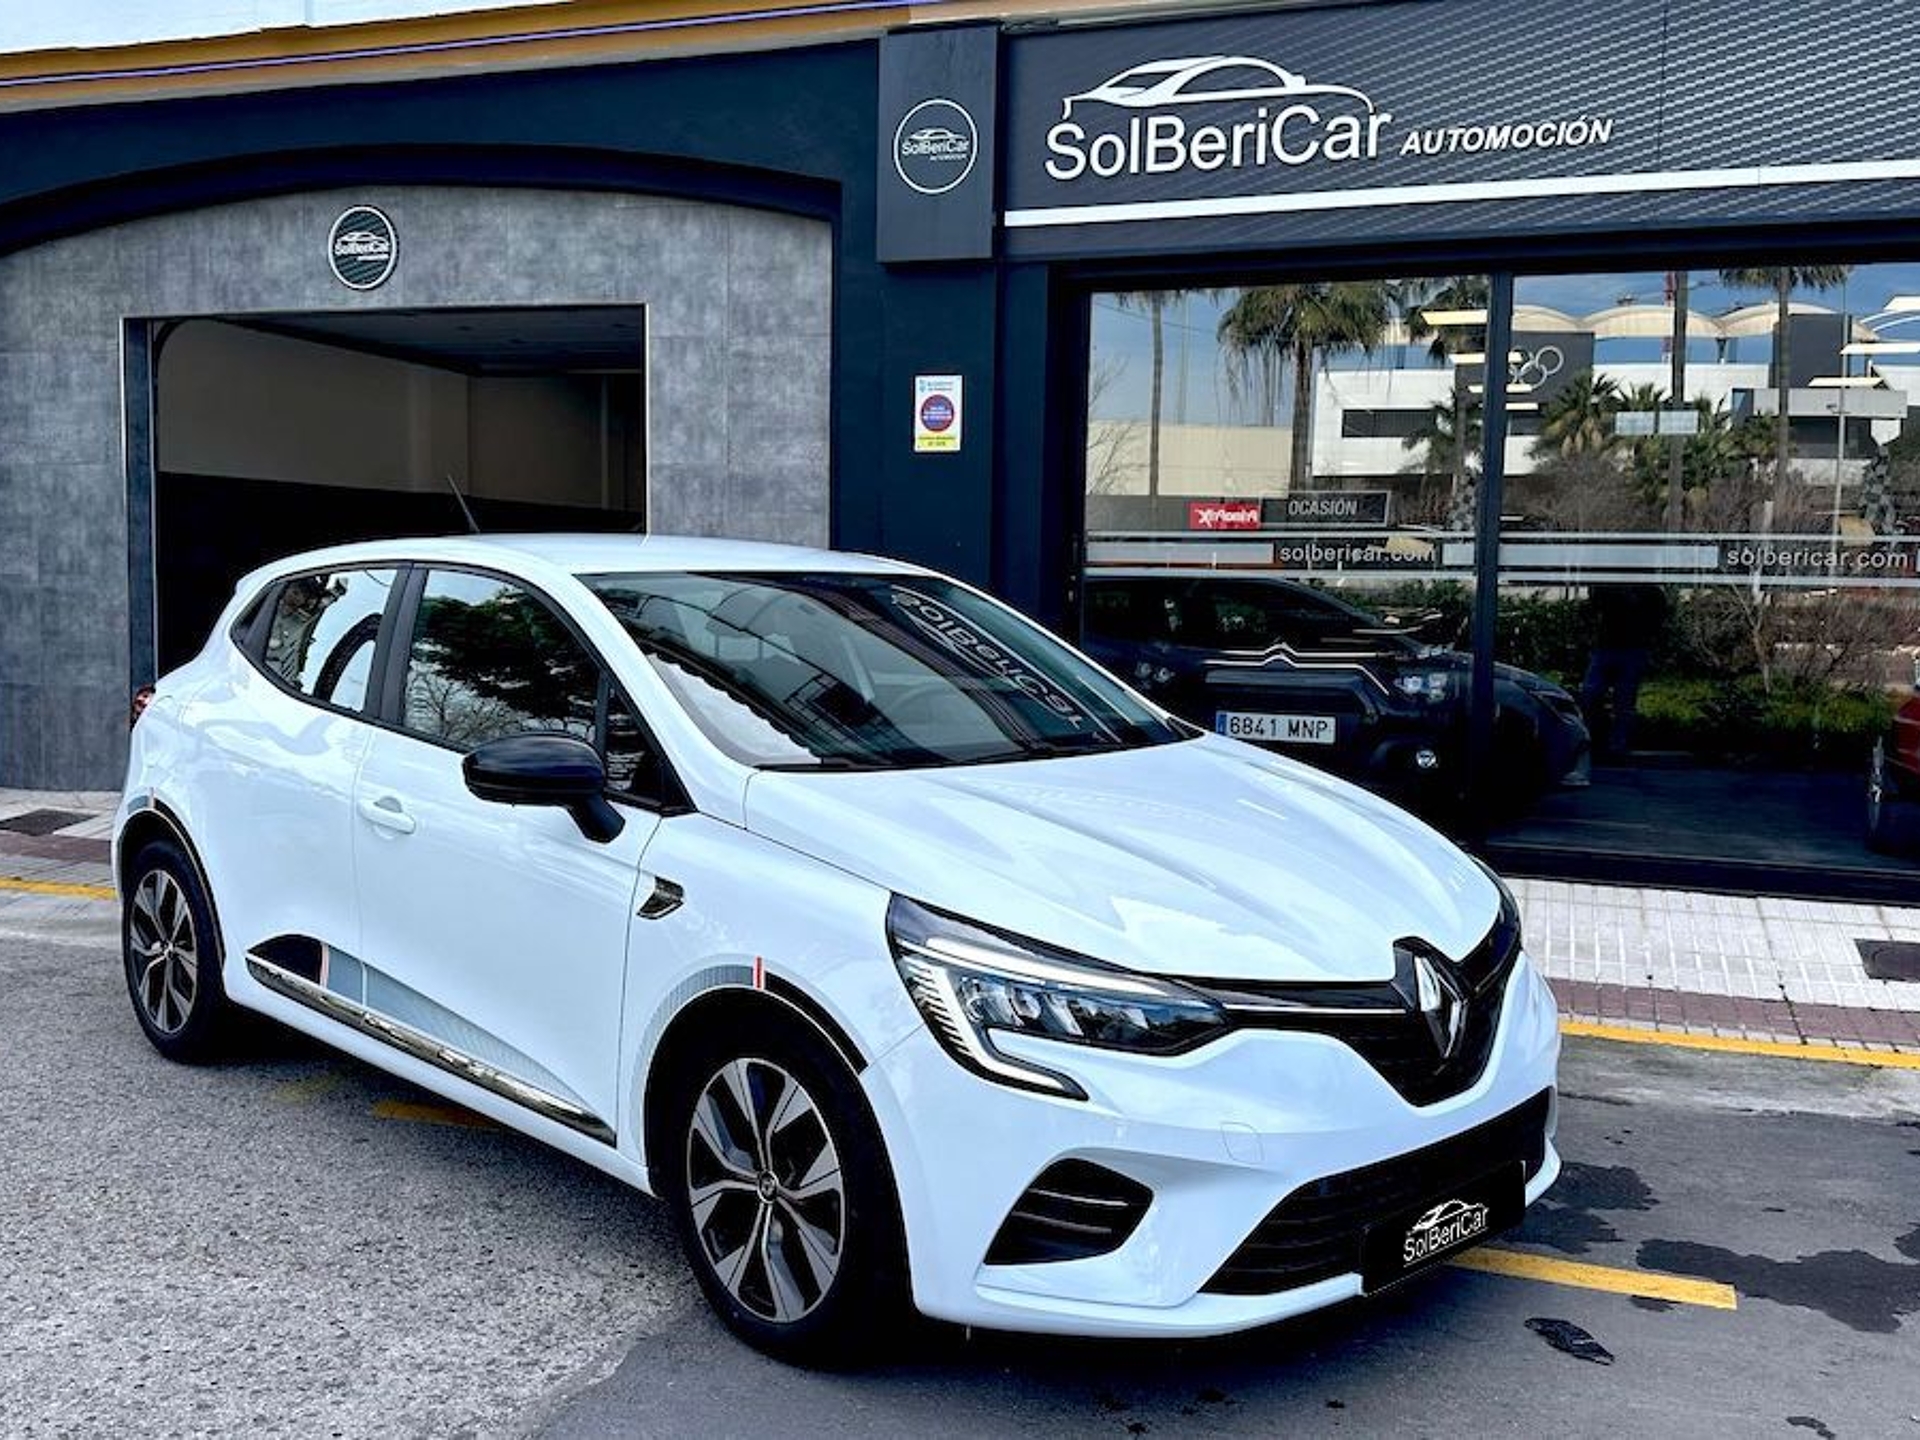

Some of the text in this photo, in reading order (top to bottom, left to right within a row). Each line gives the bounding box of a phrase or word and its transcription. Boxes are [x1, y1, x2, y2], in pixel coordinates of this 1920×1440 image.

[1045, 104, 1613, 181] SolBeriCar AUTOMOCIÓN
[1288, 496, 1358, 516] OCASIÓN
[1279, 543, 1436, 562] solbericar.com
[1726, 547, 1908, 568] solbericar.com
[1229, 716, 1328, 739] 6841 MNP
[1403, 1208, 1489, 1262] SolBeriCar
